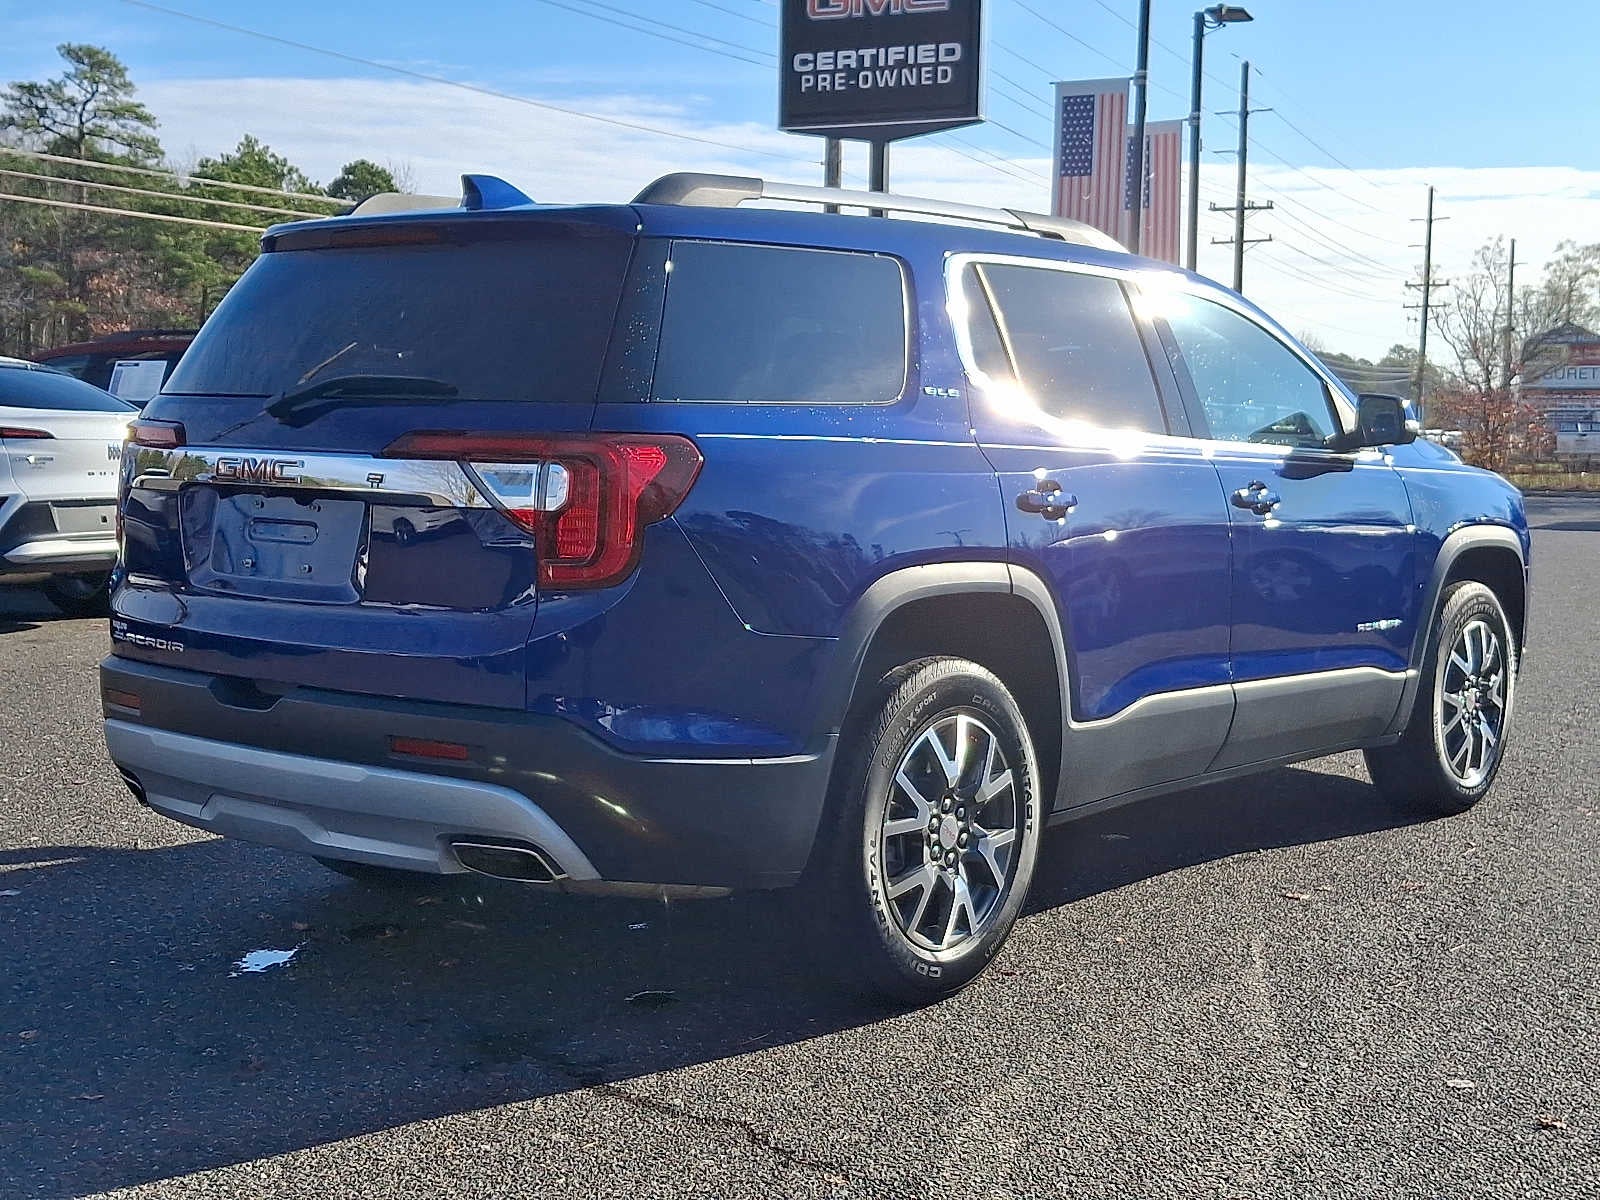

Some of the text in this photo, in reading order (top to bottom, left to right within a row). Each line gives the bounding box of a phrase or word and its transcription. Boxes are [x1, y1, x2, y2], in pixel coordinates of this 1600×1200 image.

[793, 42, 962, 72] CERTIFIED
[800, 66, 952, 92] PRE-OWNED
[215, 456, 305, 484] GMC
[914, 691, 937, 713] SPORT
